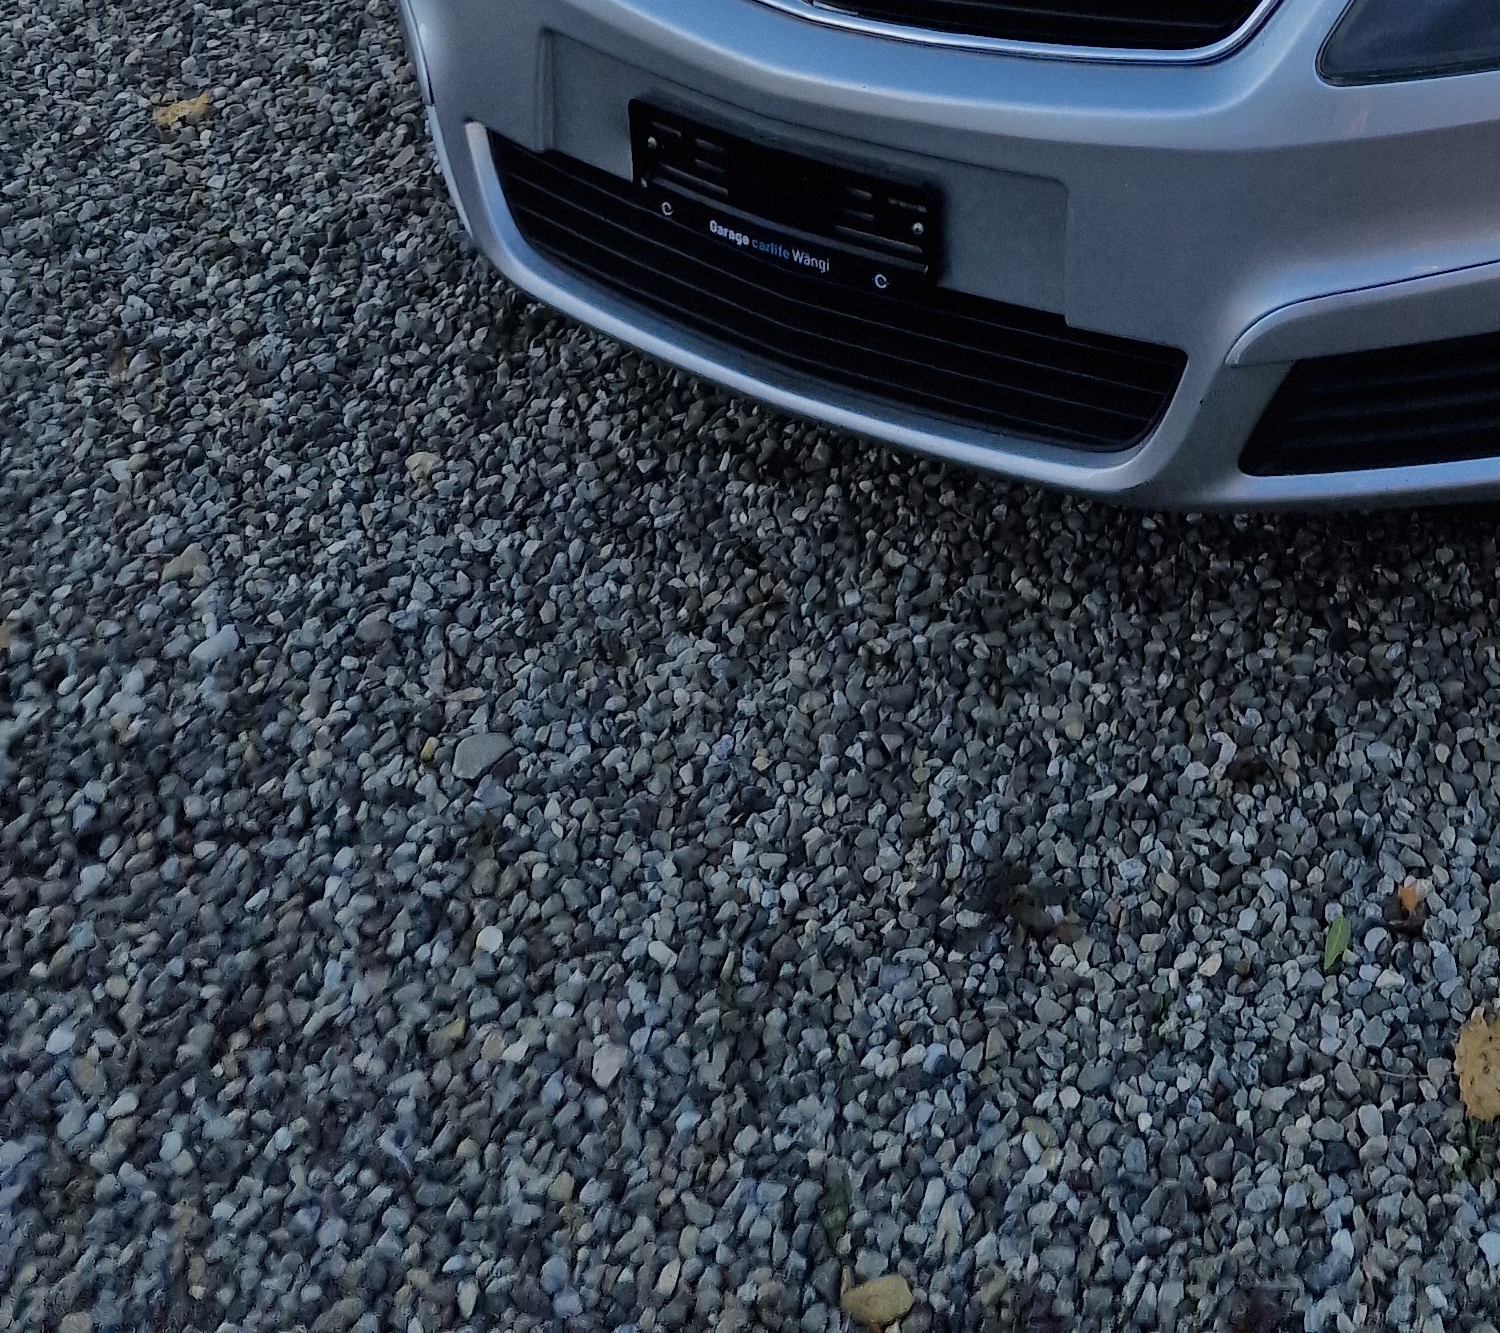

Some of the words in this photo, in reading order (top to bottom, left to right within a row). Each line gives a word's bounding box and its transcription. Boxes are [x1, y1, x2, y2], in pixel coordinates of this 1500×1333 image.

[709, 219, 750, 246] Garage
[752, 237, 791, 260] carlife
[791, 247, 830, 274] Wängi
